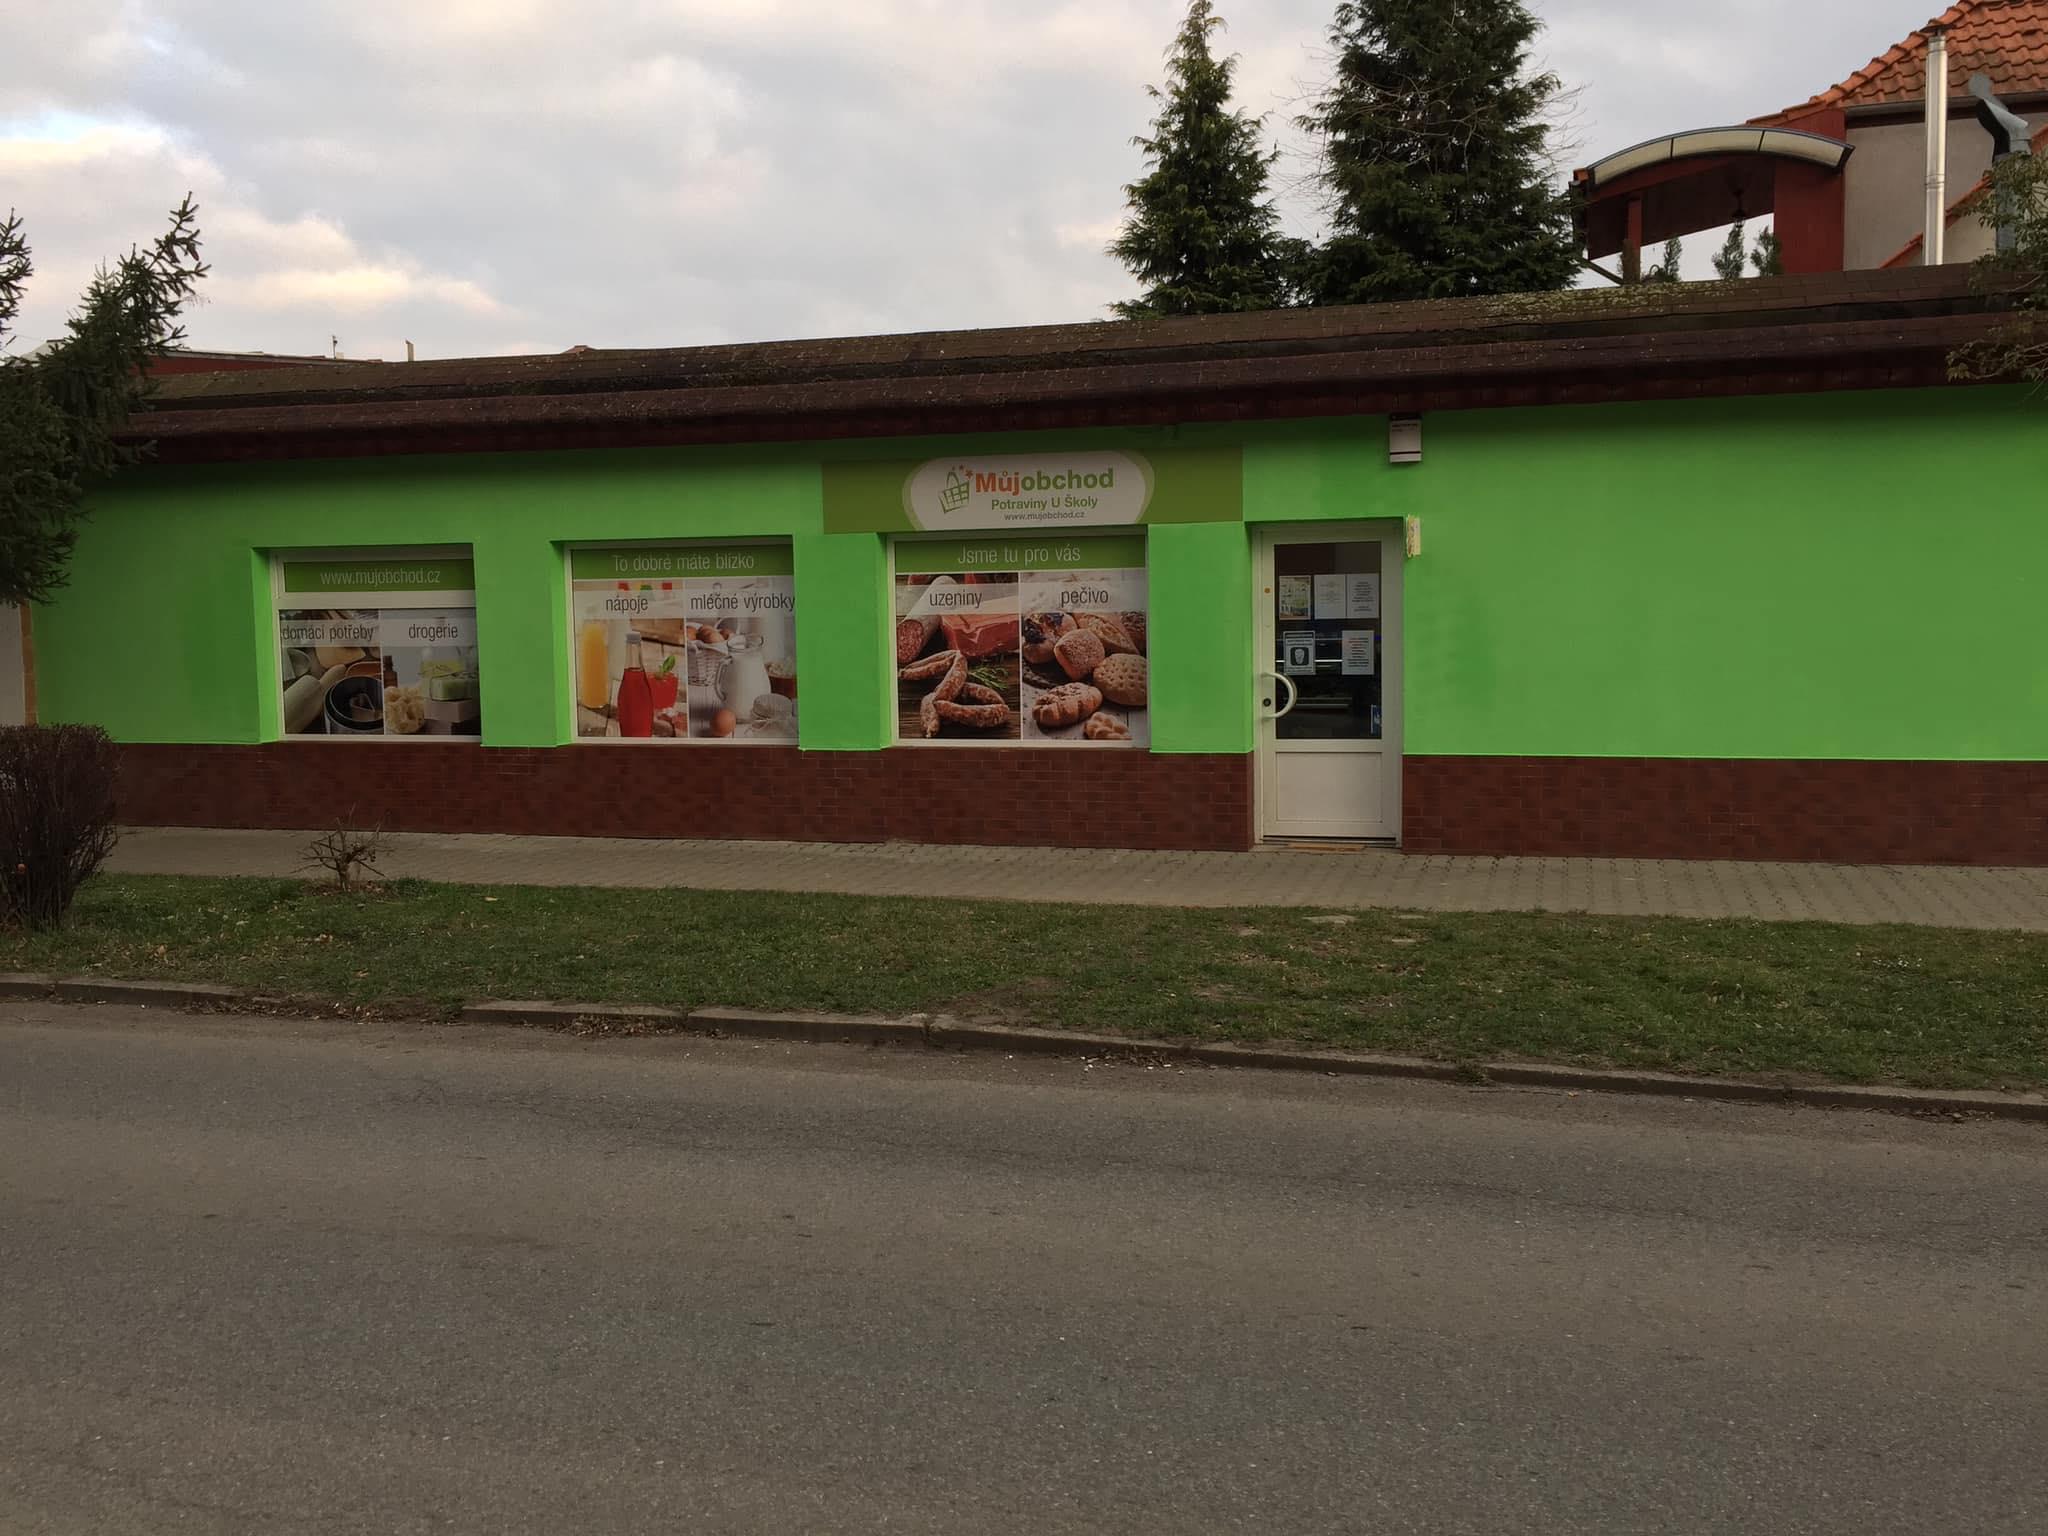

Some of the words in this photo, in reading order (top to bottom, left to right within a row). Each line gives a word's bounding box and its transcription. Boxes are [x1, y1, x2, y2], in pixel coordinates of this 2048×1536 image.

[975, 467, 1114, 496] Můjobchod
[991, 496, 1047, 511] Potraviny
[1052, 496, 1061, 508] U
[1065, 494, 1098, 510] Školy
[1004, 510, 1085, 522] www.mujobchod.cz
[613, 555, 628, 572] To
[633, 554, 672, 571] dobré
[677, 554, 711, 570] máte
[716, 552, 755, 569] blízko
[957, 547, 998, 564] Jsme
[1004, 547, 1018, 563] tu
[1024, 547, 1049, 566] pro
[1055, 544, 1081, 561] vás
[320, 568, 441, 587] www.mujobchod.cz
[605, 594, 649, 614] nápoje
[690, 592, 738, 610] mléčné
[744, 592, 796, 613] výrobky
[929, 588, 983, 609] uzeniny
[1060, 586, 1109, 608] pečivo
[282, 623, 325, 641] domácí
[329, 624, 374, 643] potřeby
[408, 623, 459, 642] drogerie
